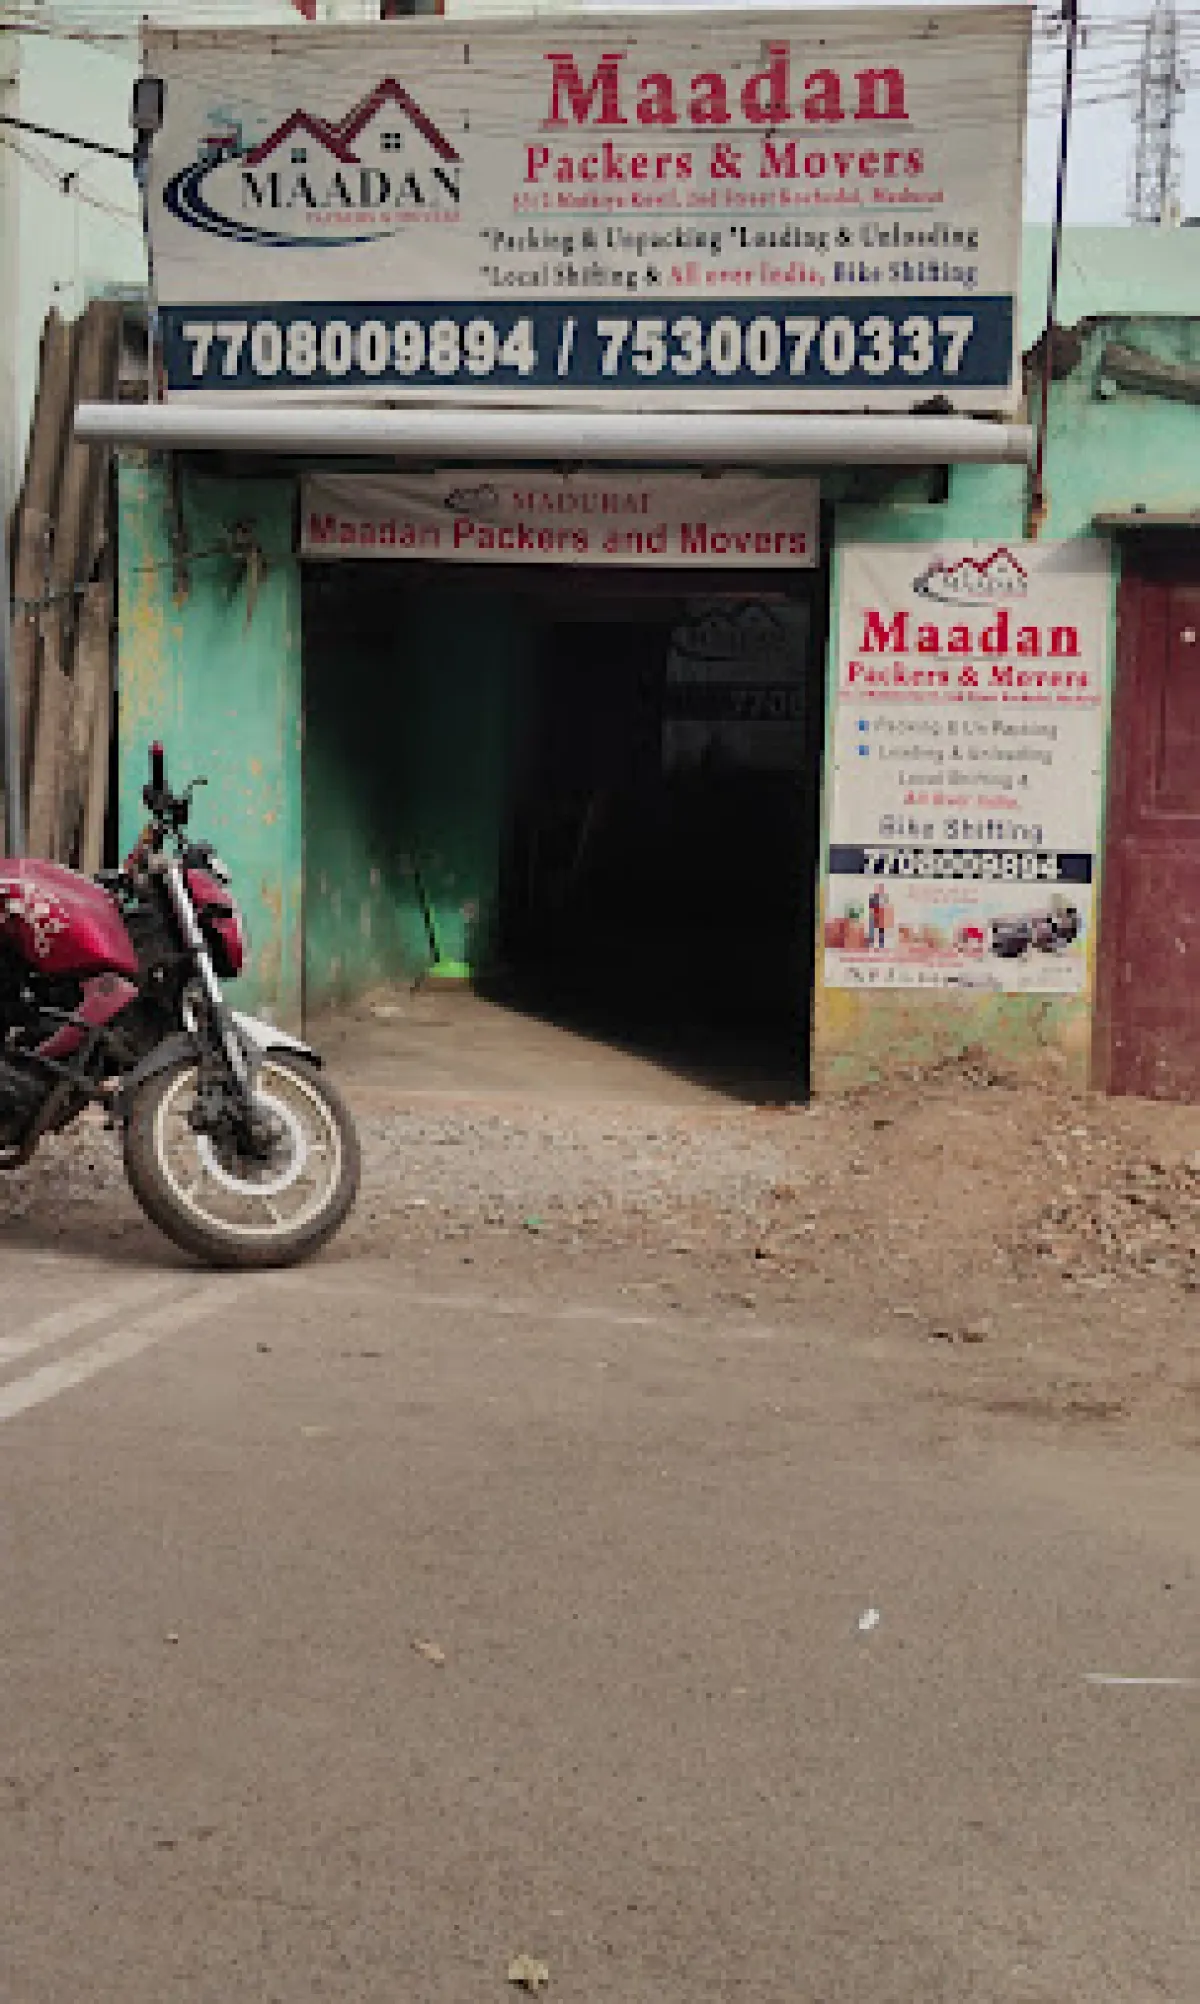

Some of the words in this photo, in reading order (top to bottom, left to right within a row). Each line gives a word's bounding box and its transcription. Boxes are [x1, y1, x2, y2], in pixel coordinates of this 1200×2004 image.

[543, 40, 909, 127] Maadan
[524, 142, 692, 183] Packers
[710, 140, 741, 180] &
[760, 140, 925, 180] Movers
[242, 168, 461, 208] MAADAN
[583, 226, 598, 248] &
[607, 226, 722, 257] Unpacking
[834, 225, 855, 248] &
[858, 221, 979, 252] Unloading
[553, 259, 638, 291] Shifting
[642, 261, 662, 286] &
[667, 260, 697, 287] All
[834, 260, 884, 284] Bike
[888, 259, 979, 291] Shifting
[182, 320, 540, 377] 7708009894
[557, 315, 577, 376] /
[597, 313, 974, 377] 7530070337
[512, 492, 653, 514] MADURAI
[309, 513, 441, 546] Maadan
[453, 517, 589, 551] Packers
[603, 522, 667, 554] and
[681, 523, 806, 555] Movers
[859, 607, 1082, 657] Maadan
[848, 661, 949, 686] Packers
[957, 665, 979, 687] &
[988, 665, 1088, 687] Movers
[878, 813, 934, 839] Bike
[943, 818, 1043, 845] Shifting
